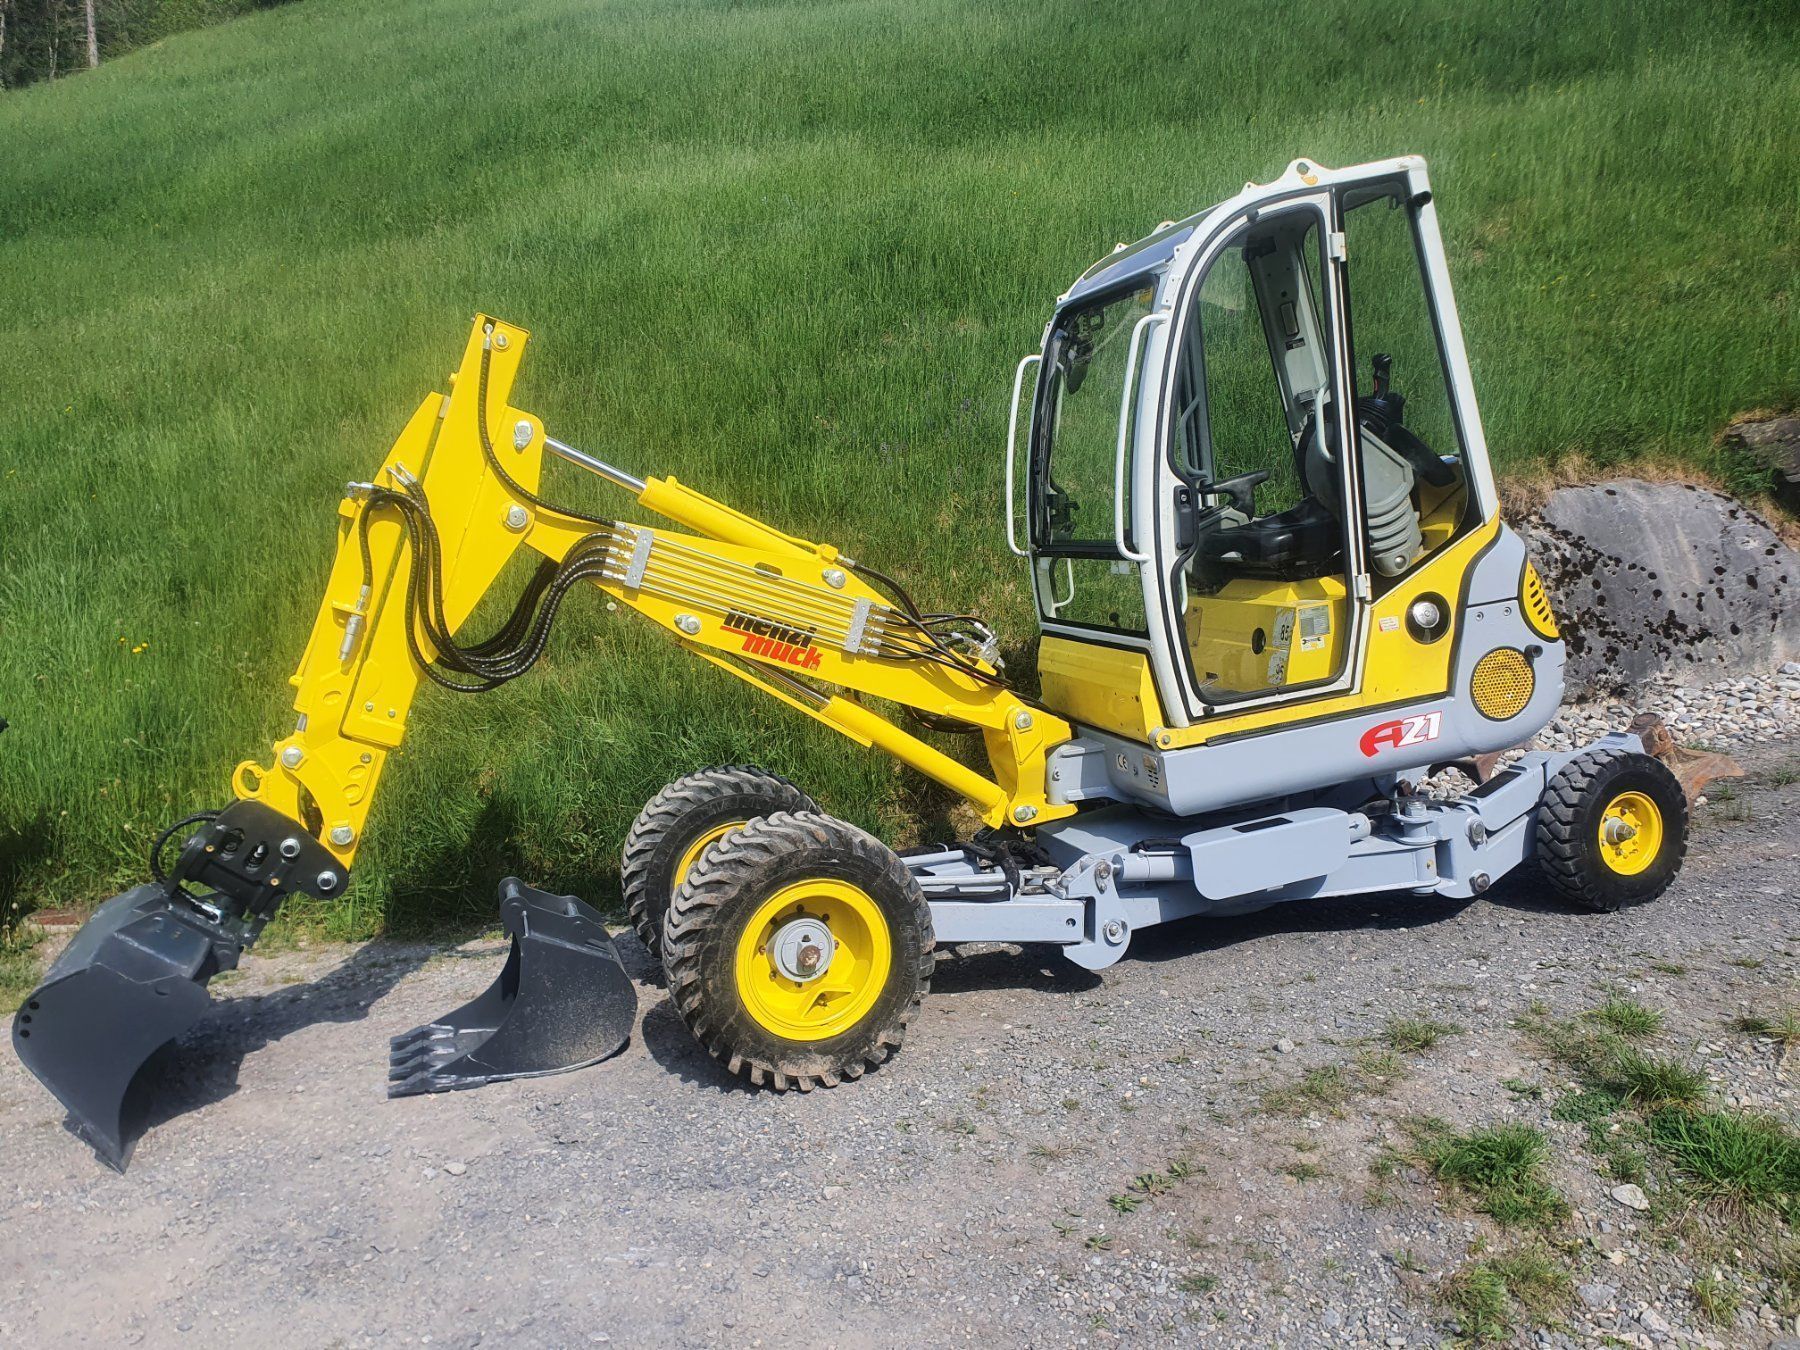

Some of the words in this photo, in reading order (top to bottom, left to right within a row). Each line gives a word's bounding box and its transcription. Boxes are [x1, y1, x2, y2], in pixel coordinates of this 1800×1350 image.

[723, 607, 818, 649] menzi
[734, 630, 823, 671] muck
[1360, 710, 1442, 757] A21
